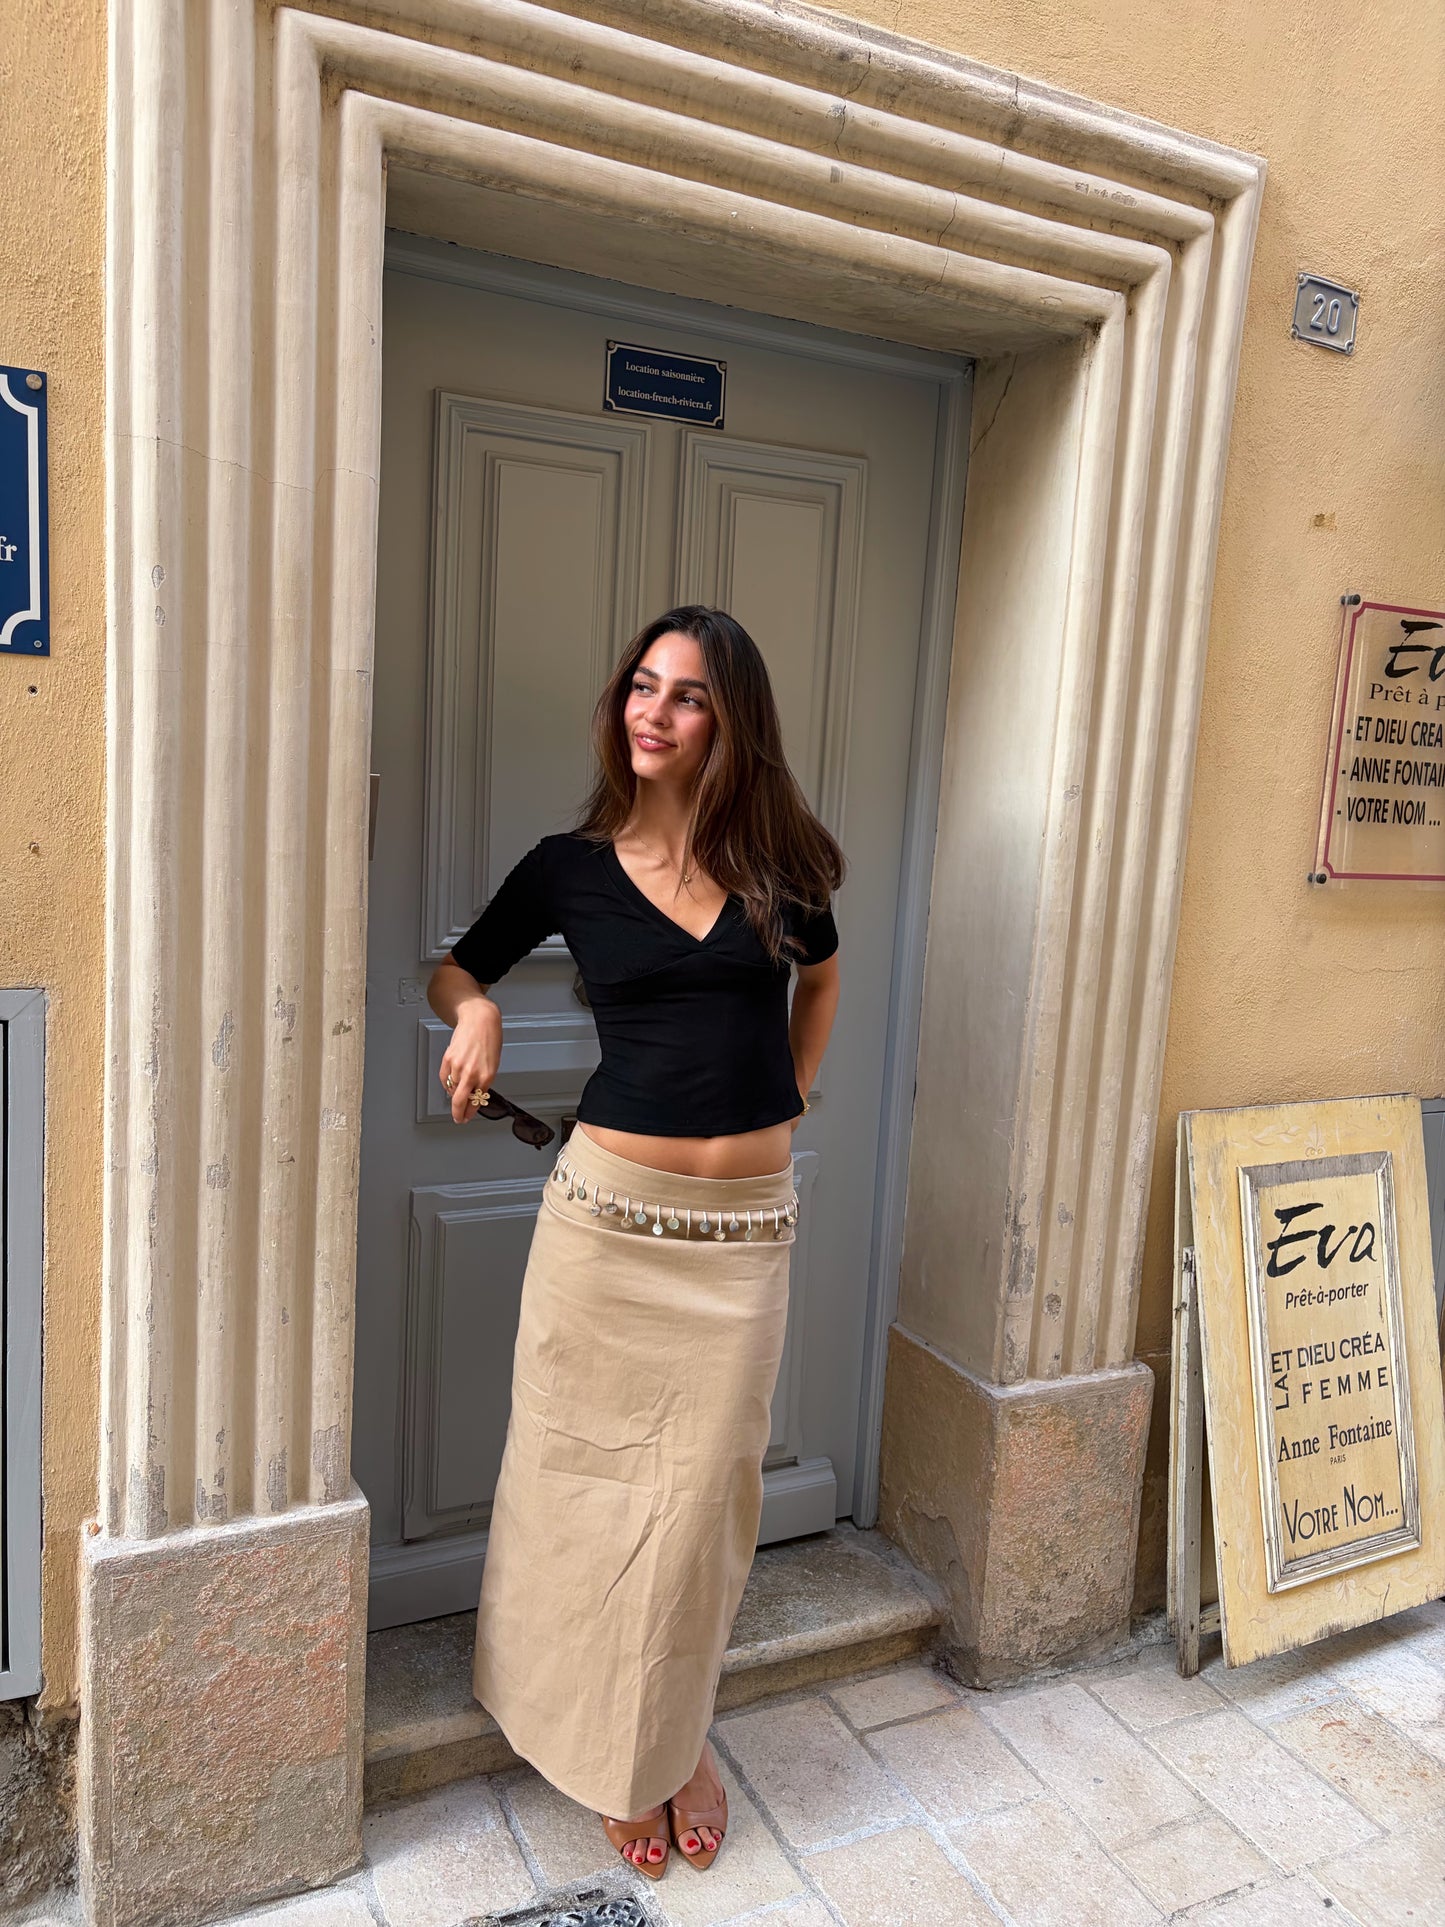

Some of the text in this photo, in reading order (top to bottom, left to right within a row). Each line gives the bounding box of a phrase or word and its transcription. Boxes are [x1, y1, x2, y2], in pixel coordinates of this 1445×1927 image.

[1310, 293, 1342, 334] 20
[625, 361, 706, 384] Location saisonnière
[618, 386, 713, 411] location-french-riviera.fr
[1369, 683, 1412, 703] Prêt
[1418, 688, 1429, 705] à
[1355, 716, 1443, 748] ET DIEU CREA
[1350, 756, 1391, 784] ANNE
[1347, 797, 1389, 823] VOTRE
[1266, 1202, 1377, 1278] Eva
[1285, 1283, 1369, 1310] Prêt-à-porter
[1271, 1331, 1386, 1374] ET DIEU CRÉA
[1274, 1366, 1389, 1411] LA FEMME
[1278, 1415, 1393, 1463] Anne Fontaine
[1330, 1453, 1347, 1465] PARIS
